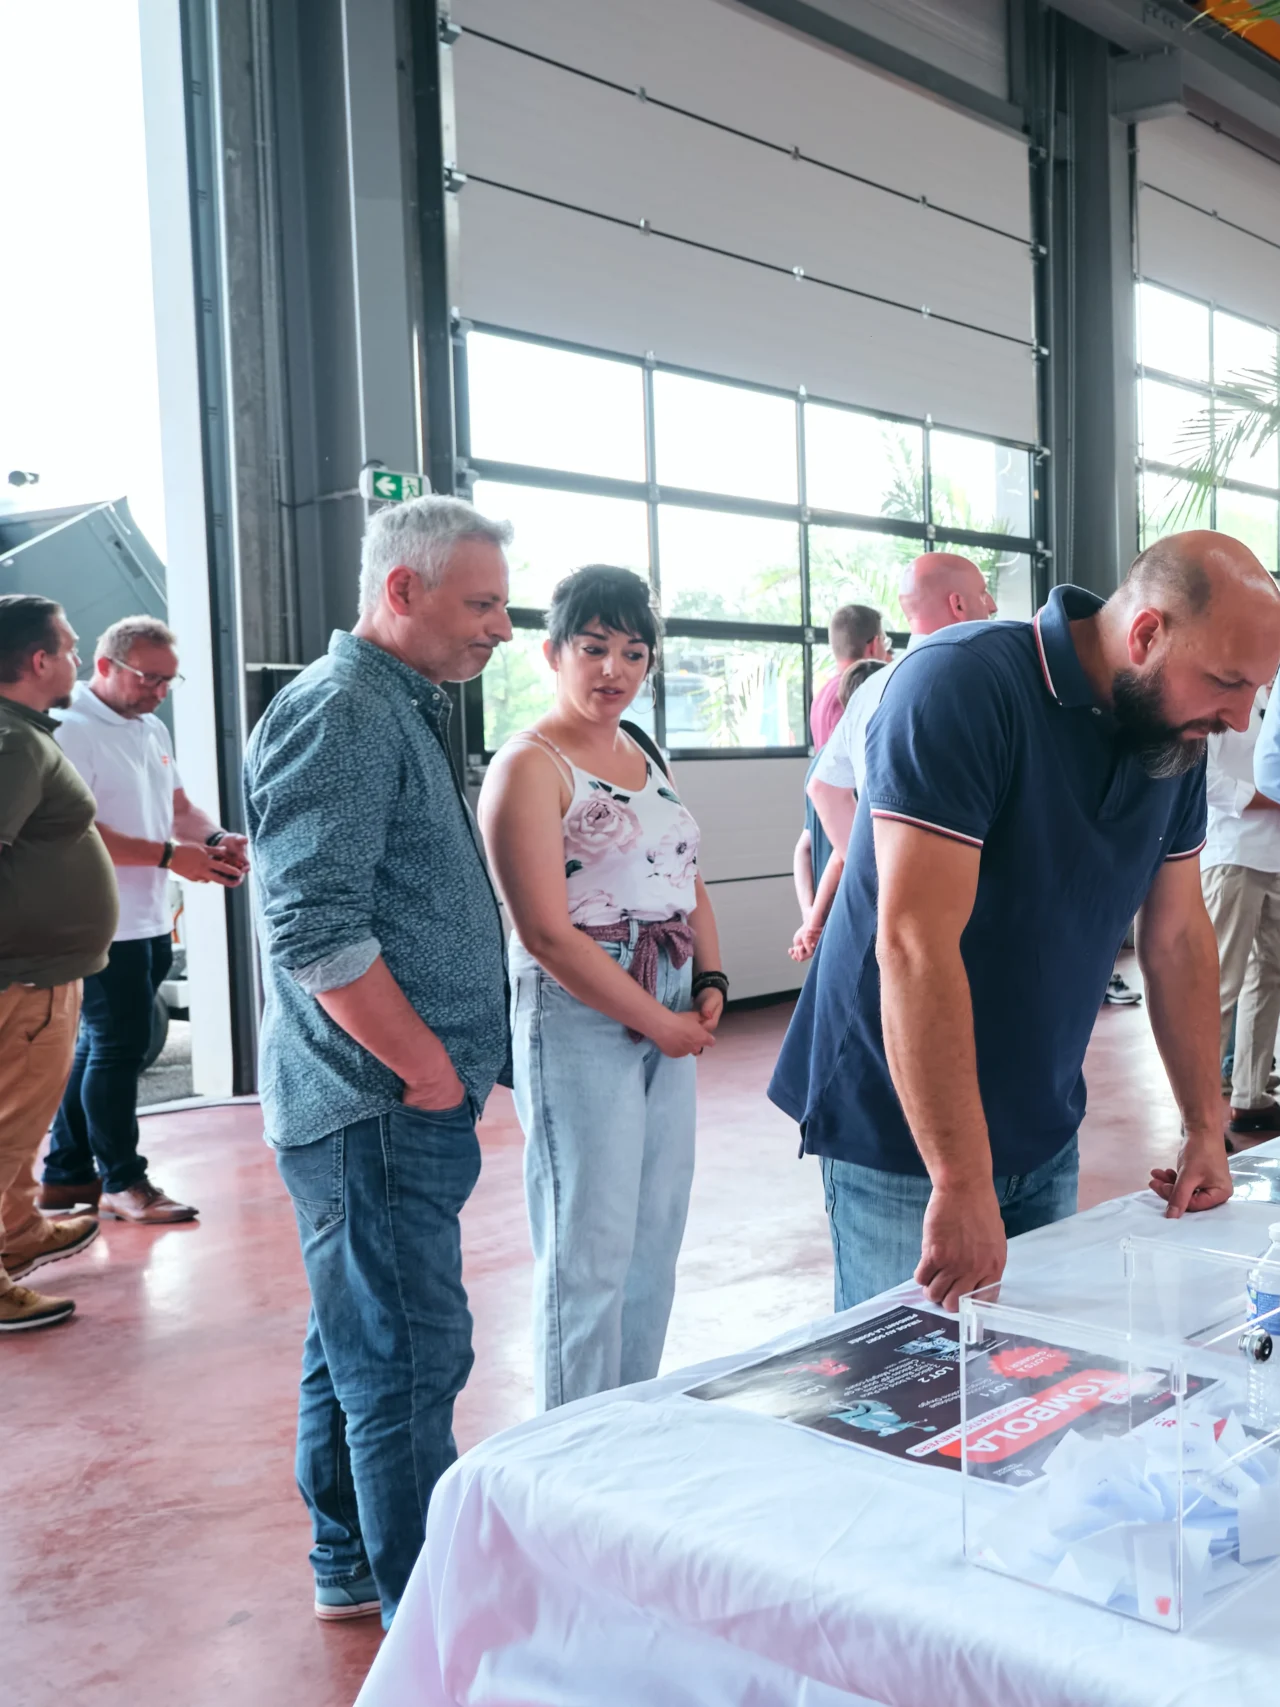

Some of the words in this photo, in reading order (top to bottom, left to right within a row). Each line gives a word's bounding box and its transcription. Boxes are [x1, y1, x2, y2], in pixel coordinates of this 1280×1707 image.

[916, 1375, 932, 1383] 2
[926, 1366, 955, 1379] LOT
[987, 1382, 1014, 1395] LOT
[962, 1376, 1118, 1453] TOMBOLA
[912, 1432, 958, 1454] NEVERS
